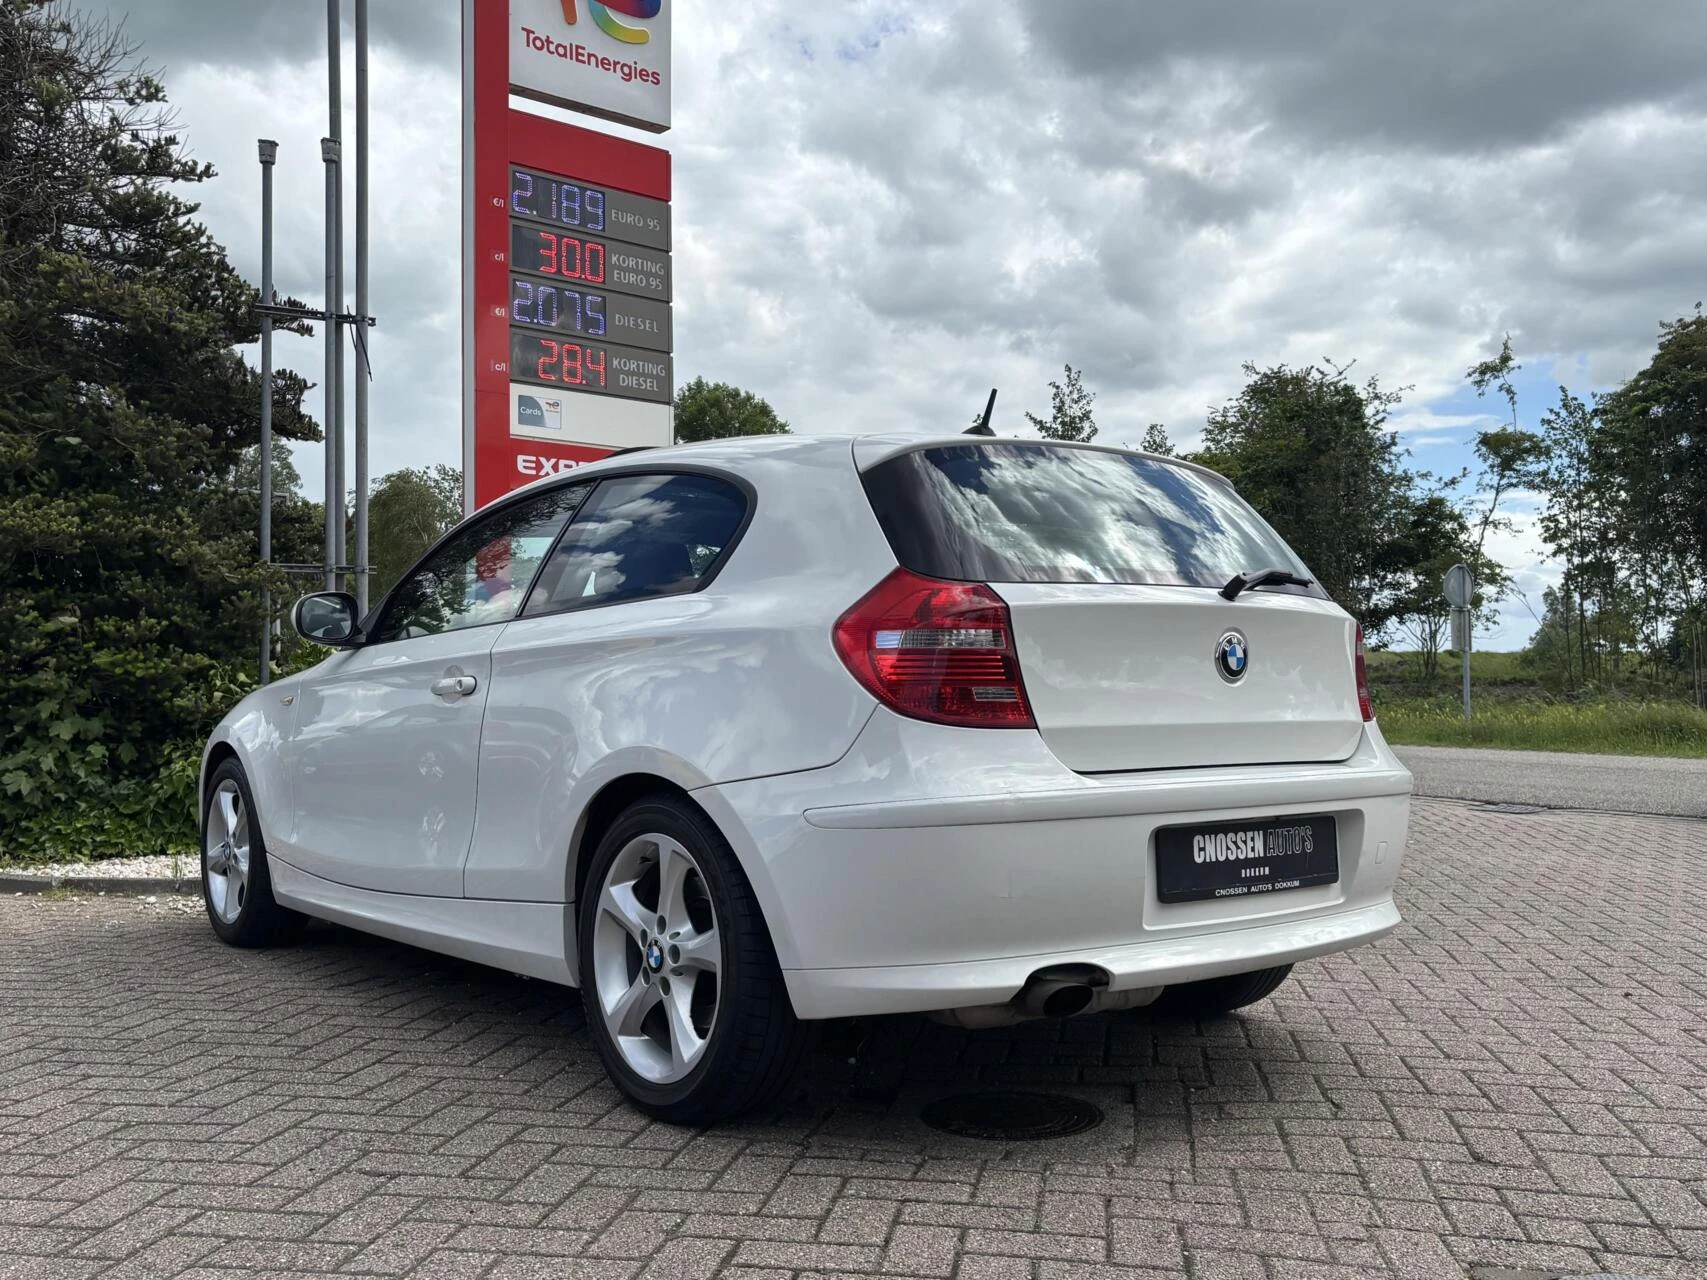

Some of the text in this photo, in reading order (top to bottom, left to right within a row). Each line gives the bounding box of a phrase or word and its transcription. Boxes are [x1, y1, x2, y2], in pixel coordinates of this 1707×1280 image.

[521, 26, 661, 86] TotalEnergies
[512, 172, 605, 231] 2.189
[611, 208, 661, 231] EURO 95
[539, 232, 606, 283] 30.0
[611, 253, 665, 275] KORTING
[613, 270, 663, 291] EURO 95
[513, 280, 605, 335] 2.075
[615, 314, 659, 333] DIESEL
[538, 340, 606, 387] 28.4
[612, 356, 666, 377] KORTING
[619, 374, 659, 391] DIESEL
[520, 406, 542, 416] Cards
[517, 454, 590, 476] EXP
[1193, 825, 1314, 864] CNOSSEN AUTO'S
[1215, 880, 1300, 897] CNOSSEN AUTO'S DOKKUM
